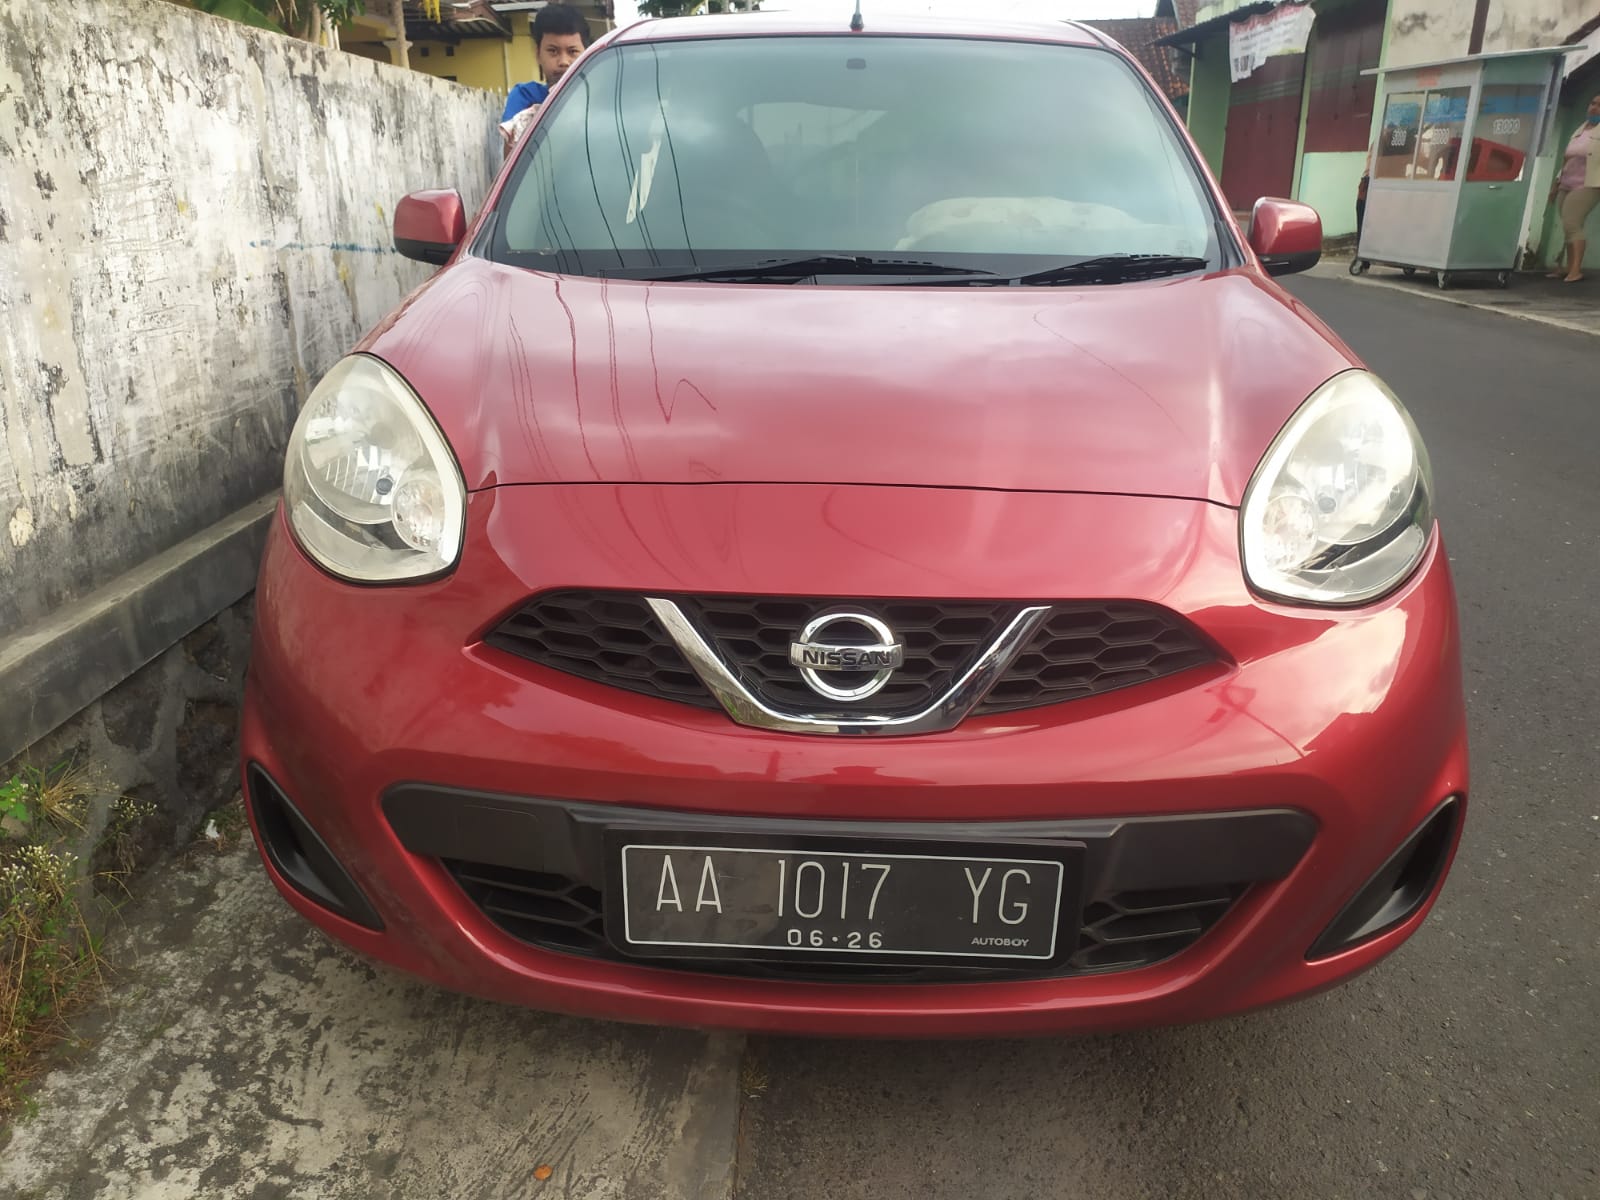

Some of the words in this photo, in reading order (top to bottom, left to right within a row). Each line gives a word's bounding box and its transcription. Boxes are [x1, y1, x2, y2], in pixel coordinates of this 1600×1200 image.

[803, 650, 890, 665] NISSAN
[656, 855, 722, 913] AA
[778, 860, 891, 920] 1017
[964, 867, 1031, 924] YG
[971, 937, 1029, 947] AUTOBOY
